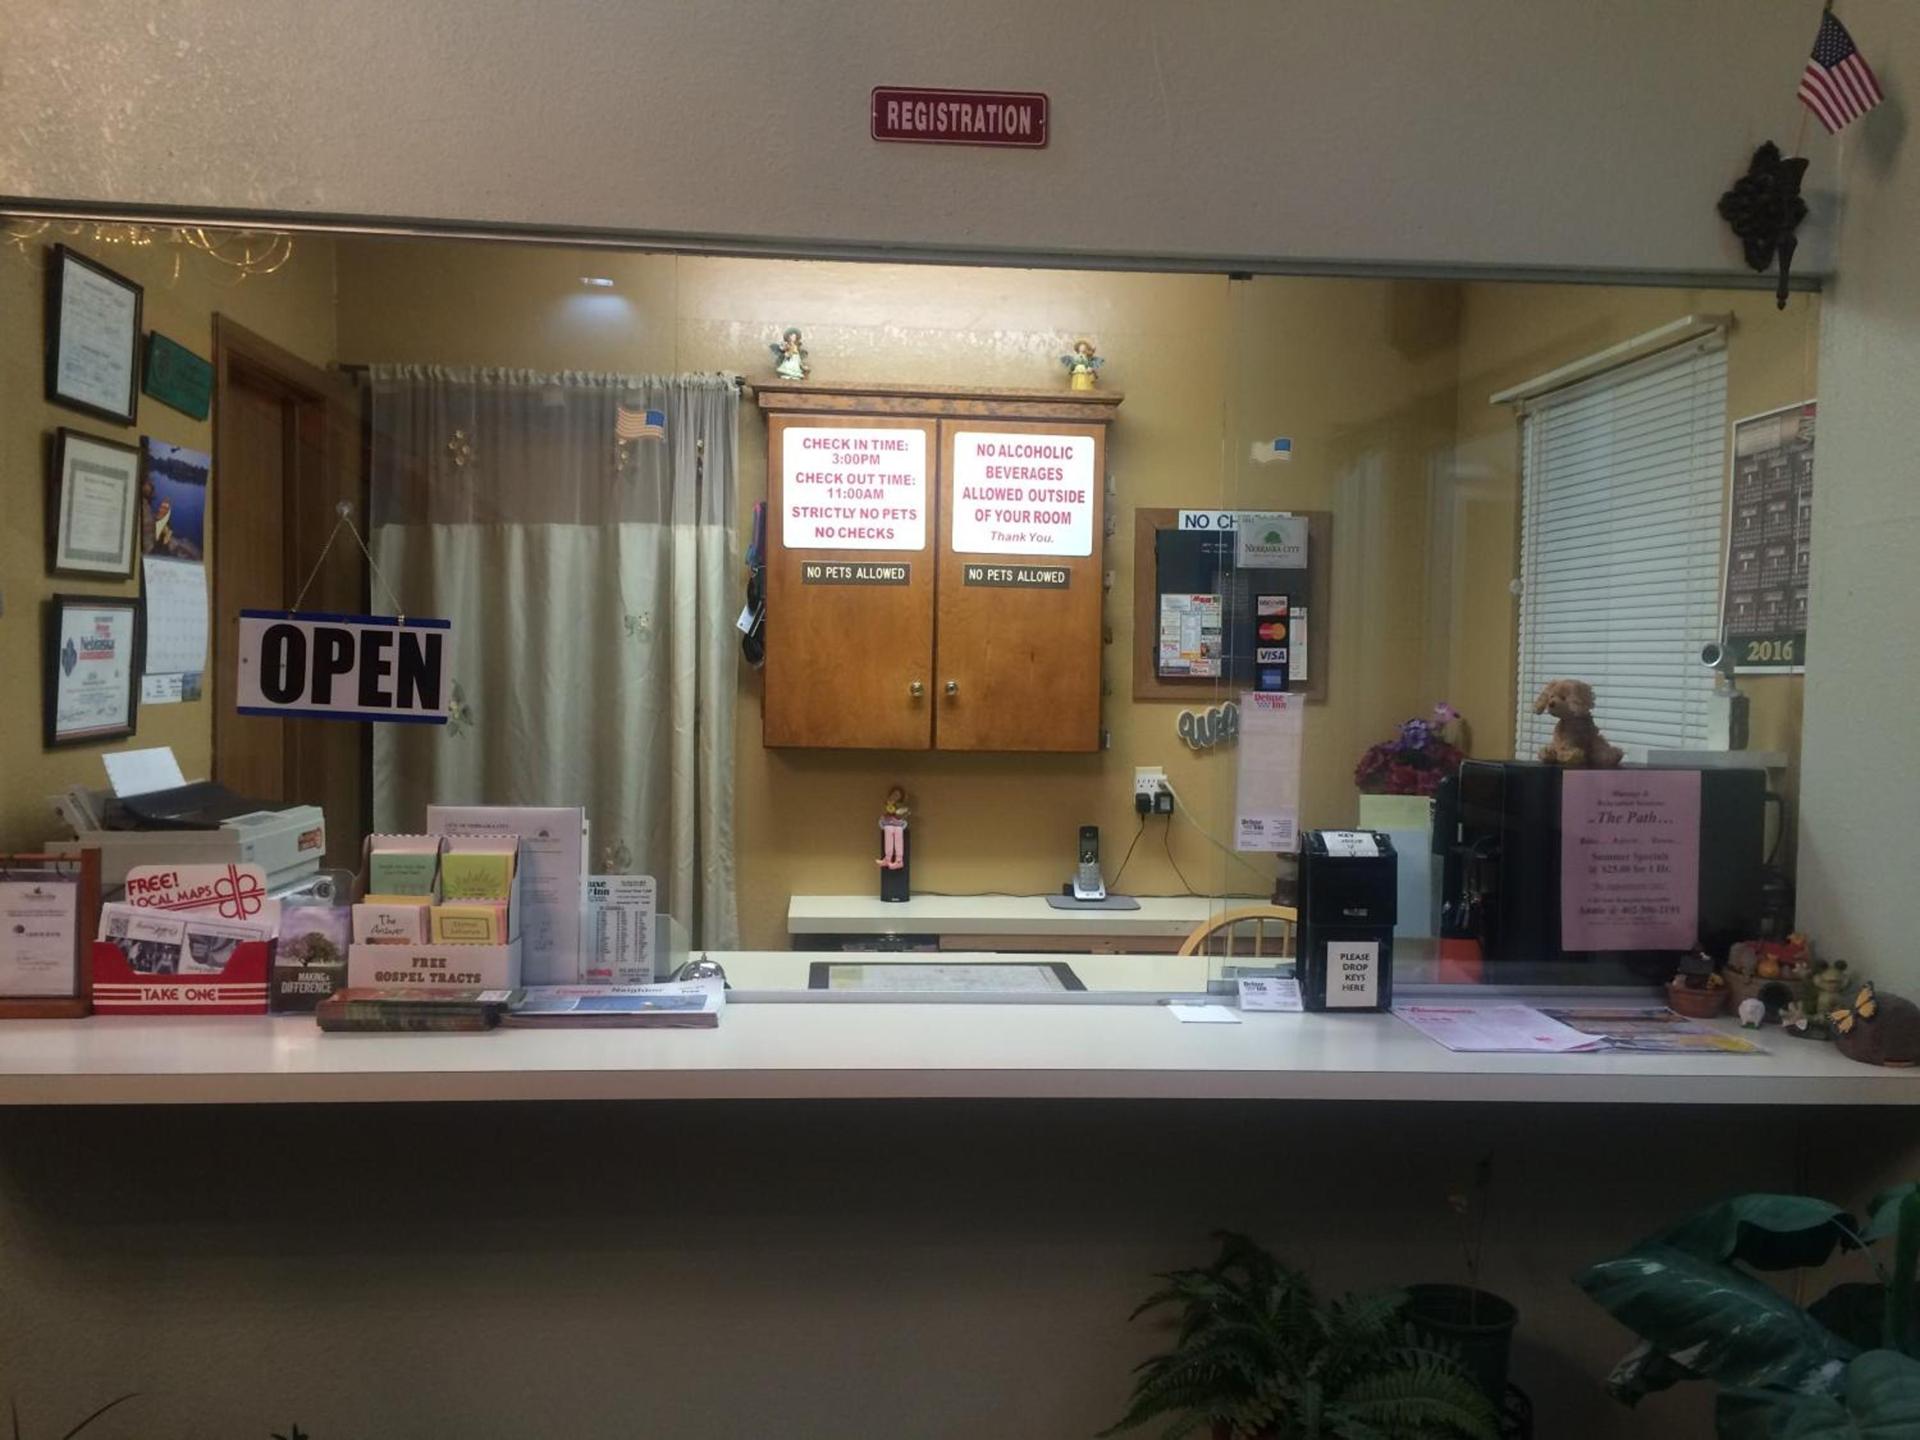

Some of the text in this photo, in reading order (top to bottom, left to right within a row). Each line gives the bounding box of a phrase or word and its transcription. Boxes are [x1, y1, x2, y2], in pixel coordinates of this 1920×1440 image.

[887, 101, 1031, 135] REGISTRATION
[802, 438, 909, 451] CHECK IN TIME:
[976, 443, 1074, 460] NO ALCOHOLIC
[832, 453, 880, 465] 3:00PM
[795, 472, 916, 486] CHECK OUT TIME:
[985, 465, 1064, 481] BEVERAGES
[827, 487, 885, 500] 11:00AM
[962, 486, 1086, 504] ALLOWED OUTSIDE
[792, 506, 918, 520] STRICTLY NO PETS
[974, 509, 1072, 525] OF YOUR ROOM
[1185, 513, 1210, 529] NO
[815, 527, 895, 540] NO CHECKS
[990, 531, 1055, 543] Thank You.
[806, 567, 906, 580] NO PETS ALLOWED
[968, 569, 1065, 583] NO PETS ALLOWED
[1260, 650, 1285, 660] VISA
[1747, 640, 1793, 661] 2016
[260, 623, 443, 710] OPEN
[128, 872, 180, 895] FREE!
[177, 885, 212, 901] MAPS
[411, 957, 448, 968] FREE
[1340, 952, 1370, 960] PLEASE
[1342, 963, 1369, 971] DROP
[374, 971, 482, 983] GOSPEL TRACTS
[1344, 973, 1366, 981] KEYS
[1342, 983, 1366, 991] HERE
[143, 988, 216, 1001] TAKE ONE
